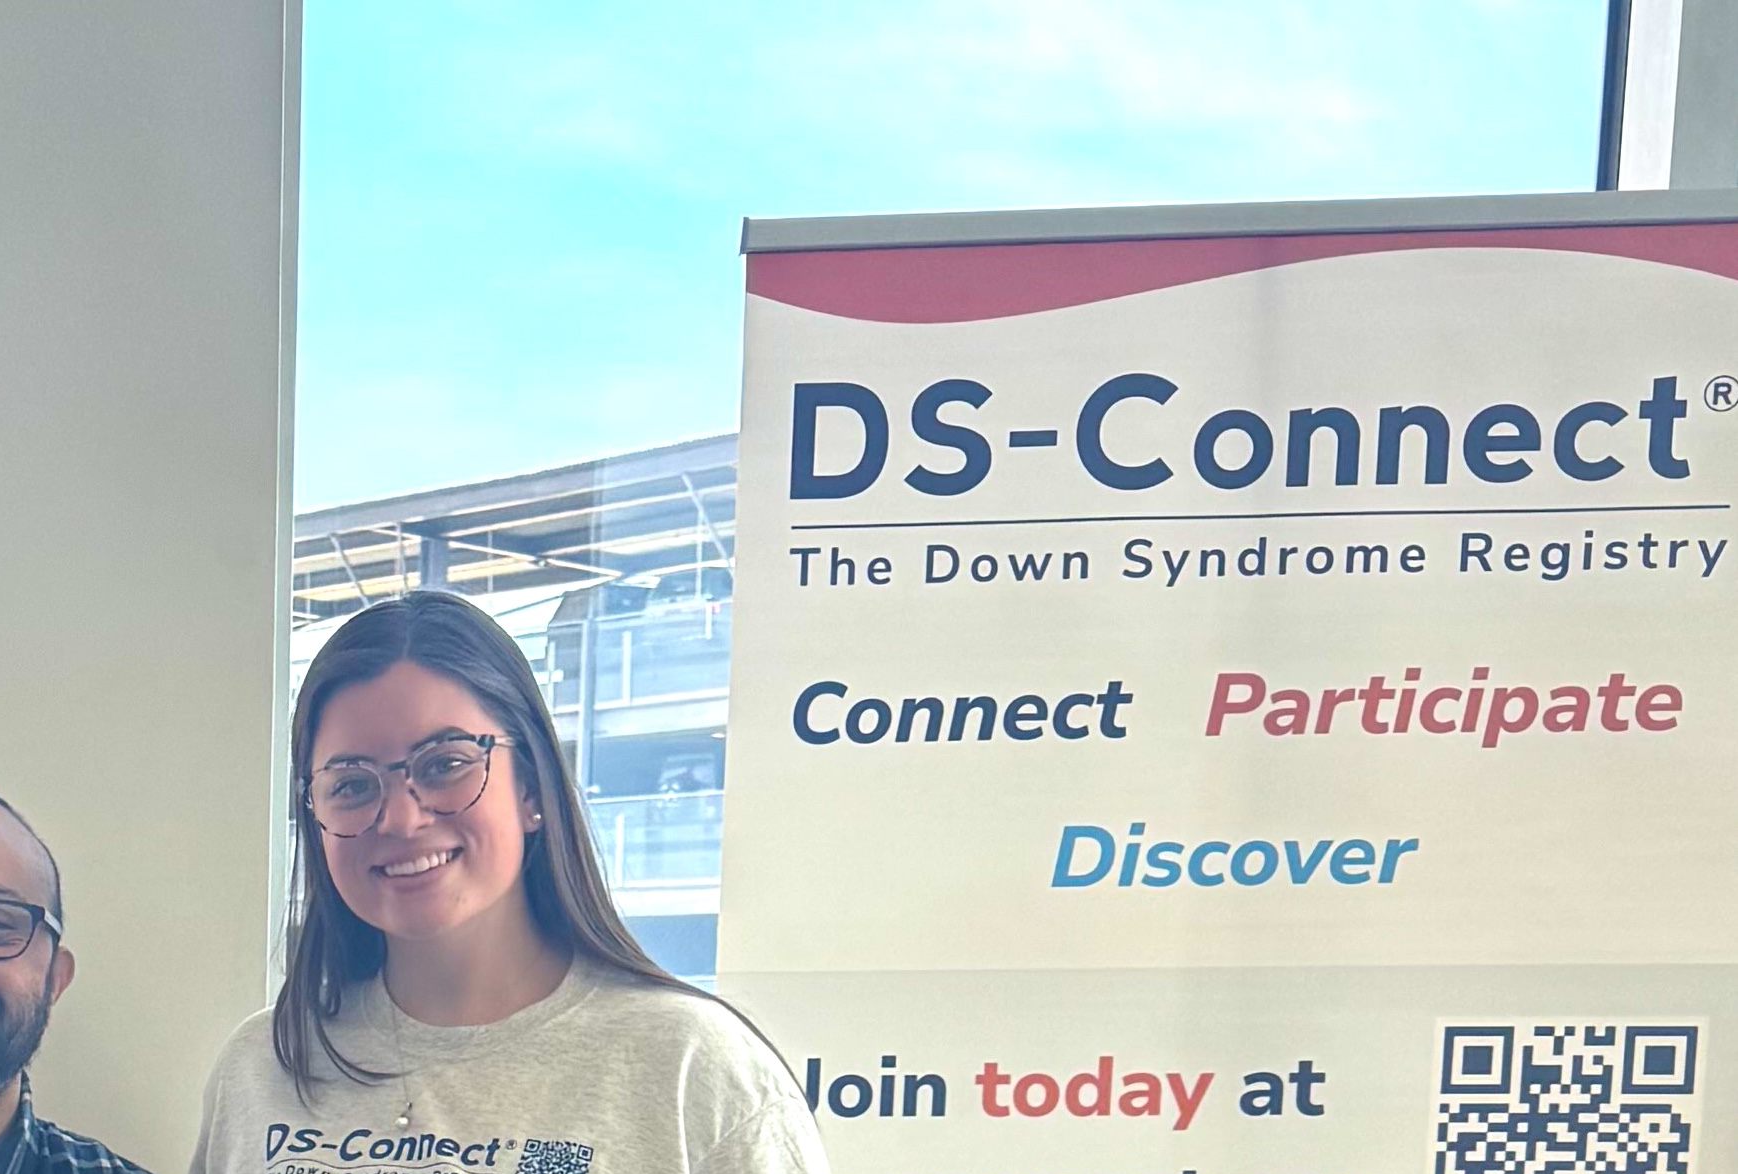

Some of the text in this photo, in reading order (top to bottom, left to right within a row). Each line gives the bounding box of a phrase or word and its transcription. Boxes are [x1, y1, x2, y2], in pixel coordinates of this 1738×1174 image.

[789, 528, 1729, 588] The Down Syndrome Registry
[792, 666, 1683, 749] Connect Participate
[1050, 822, 1419, 889] Discover
[805, 1055, 1326, 1131] Join today at
